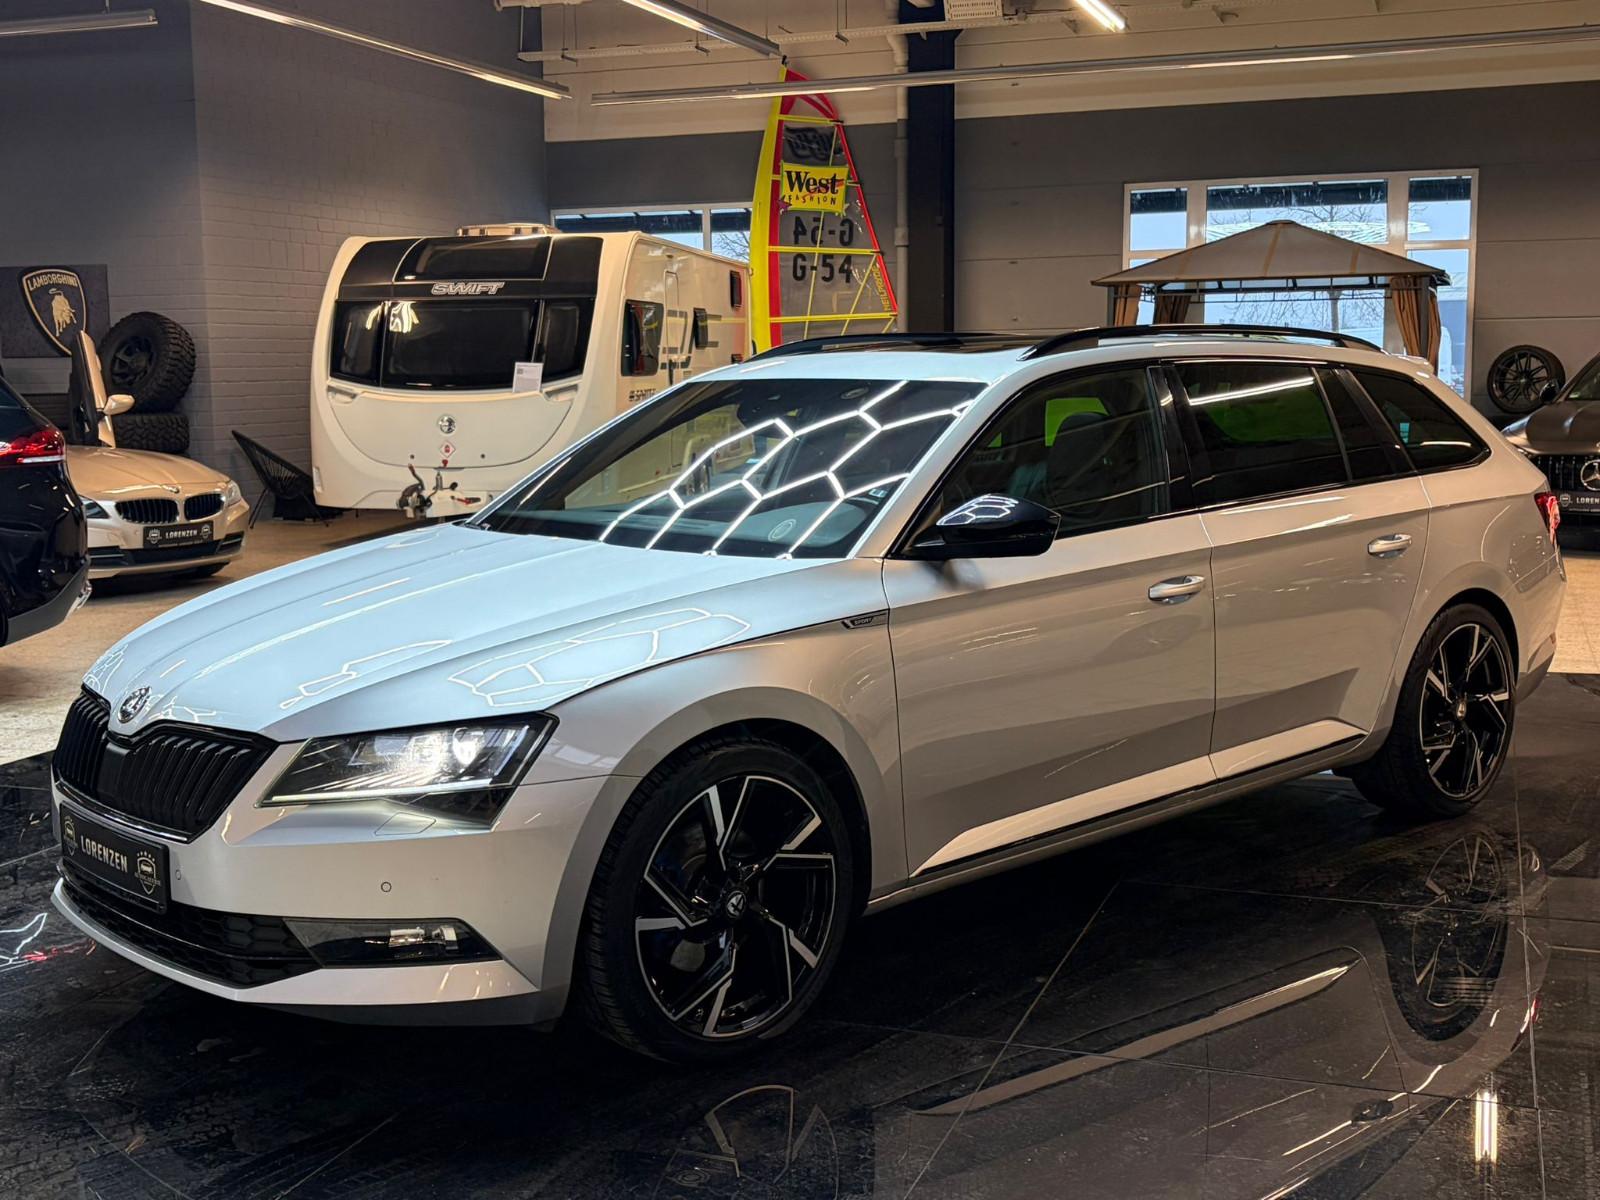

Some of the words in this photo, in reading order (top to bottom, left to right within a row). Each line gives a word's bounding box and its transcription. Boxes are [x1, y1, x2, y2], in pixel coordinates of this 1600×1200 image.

[785, 170, 839, 195] West
[788, 194, 837, 206] FASHION
[792, 253, 852, 283] G-54
[27, 273, 79, 291] LAMBORGHINI
[431, 281, 505, 296] SWIFT
[165, 529, 198, 539] LORENZEN
[80, 835, 128, 873] LORENZEN
